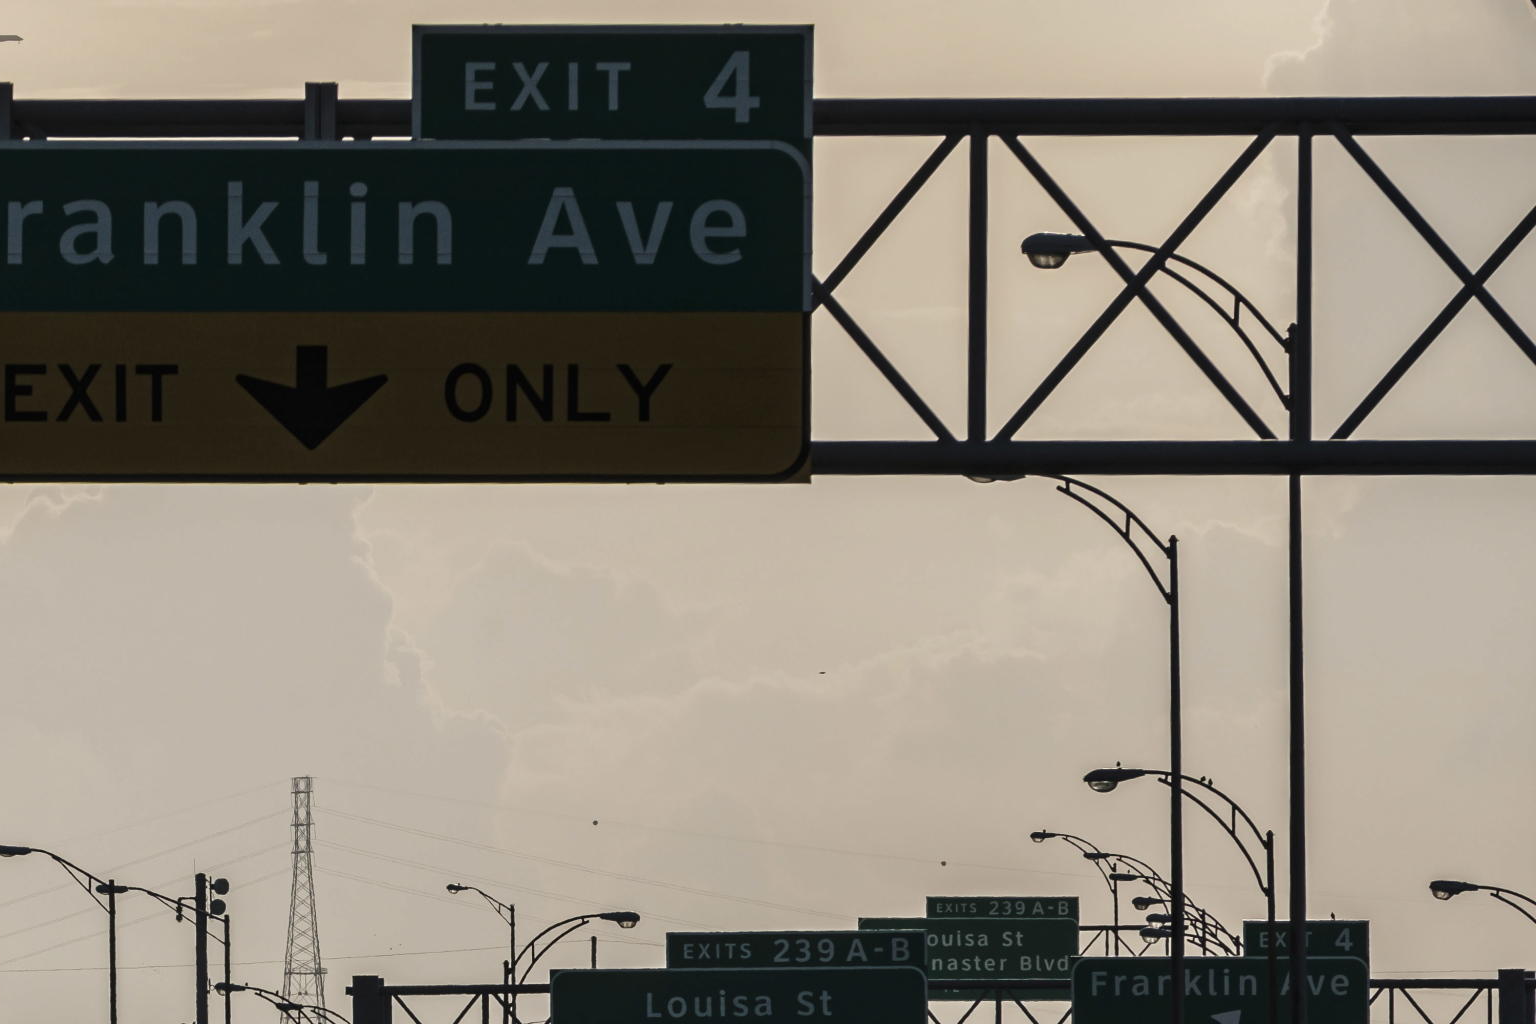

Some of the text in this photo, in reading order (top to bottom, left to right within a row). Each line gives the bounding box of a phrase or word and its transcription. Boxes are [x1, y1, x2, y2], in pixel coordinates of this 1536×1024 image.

[464, 51, 761, 124] EXIT 4
[527, 187, 748, 265] Ave
[4, 362, 674, 423] EXIT ONLY
[935, 901, 1069, 915] EXITS 239 A-B
[683, 938, 910, 963] EXITS 239 A-B
[927, 930, 1024, 947] ouisa St
[1259, 928, 1353, 951] EXT 4
[931, 955, 1069, 971] naster Blvd
[646, 990, 832, 1018] Louisa St
